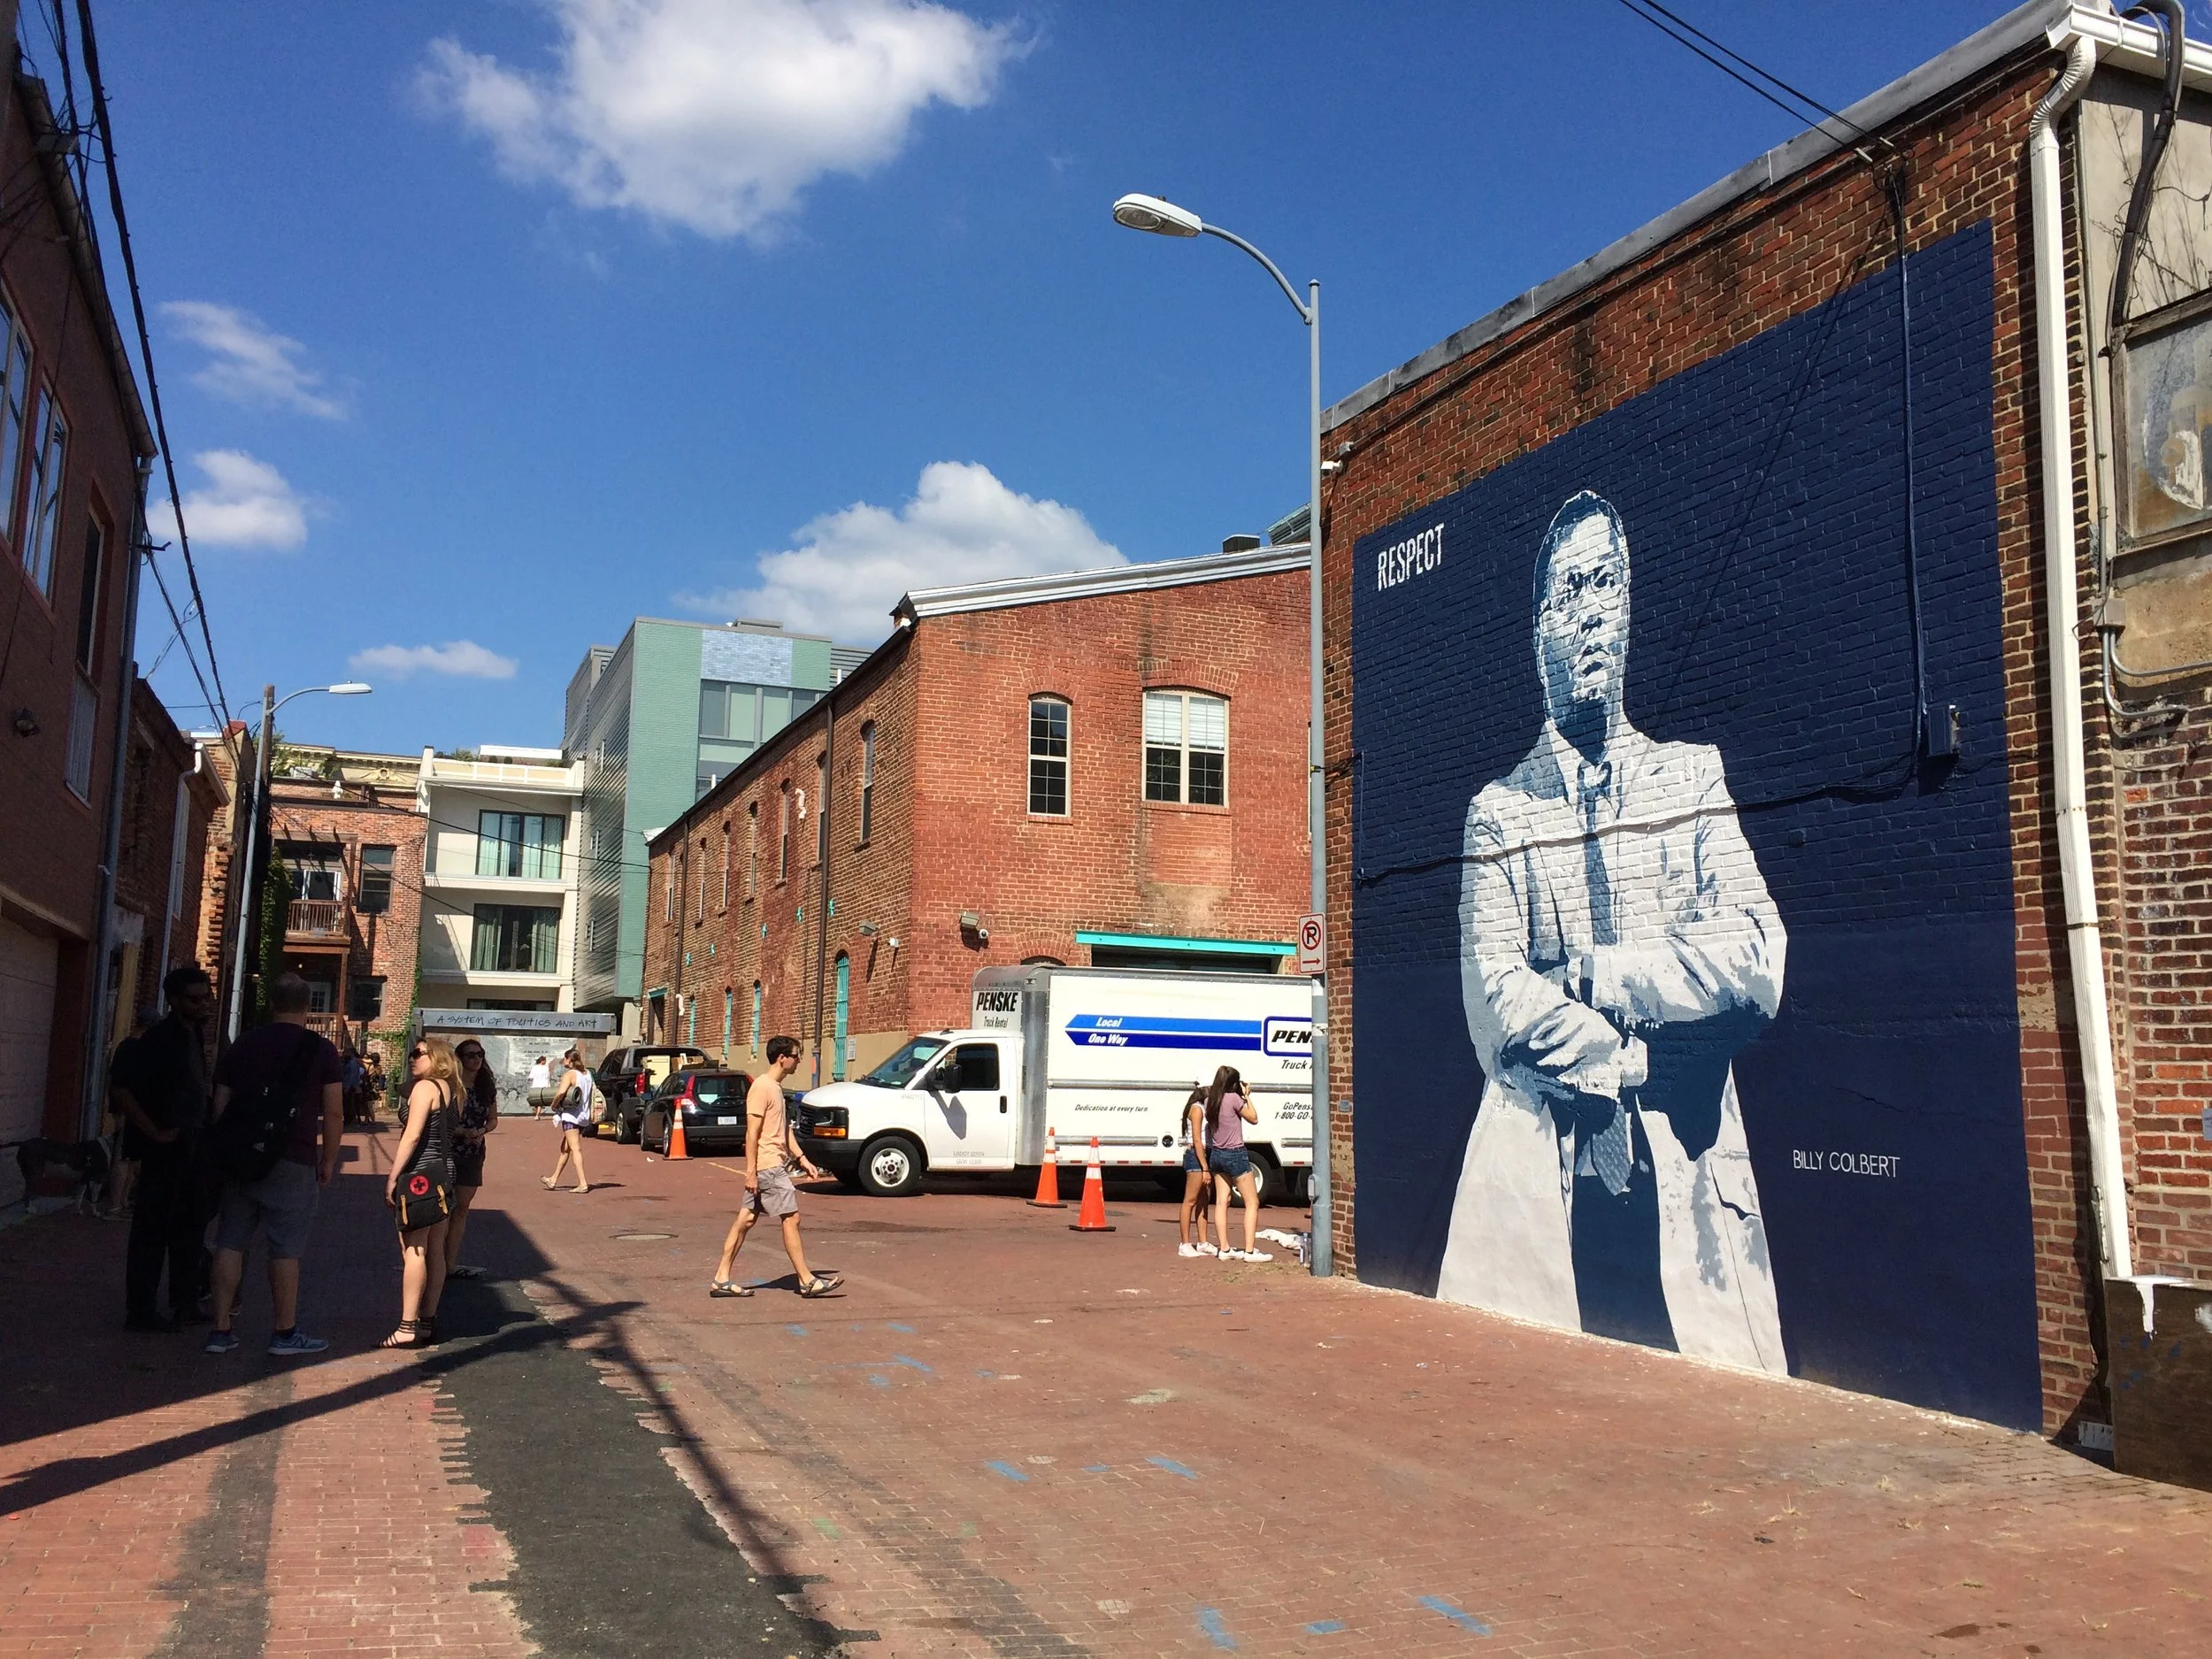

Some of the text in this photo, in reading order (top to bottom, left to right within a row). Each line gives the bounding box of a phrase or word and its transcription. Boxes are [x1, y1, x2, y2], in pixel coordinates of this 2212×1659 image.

[1378, 522, 1445, 592] RESPECT
[975, 991, 1018, 1012] PENSKE
[437, 1015, 444, 1024] A
[578, 1019, 597, 1029] ART
[983, 1016, 1009, 1028] Truck Rental
[1095, 1017, 1123, 1027] Local
[1087, 1033, 1129, 1046] One Way
[1271, 1030, 1312, 1043] PEN
[1281, 1059, 1308, 1070] Truck
[1283, 1102, 1313, 1110] GoPens
[1274, 1111, 1313, 1120] 1-800-GO-
[1793, 1149, 1901, 1178] BILLY COLBERT
